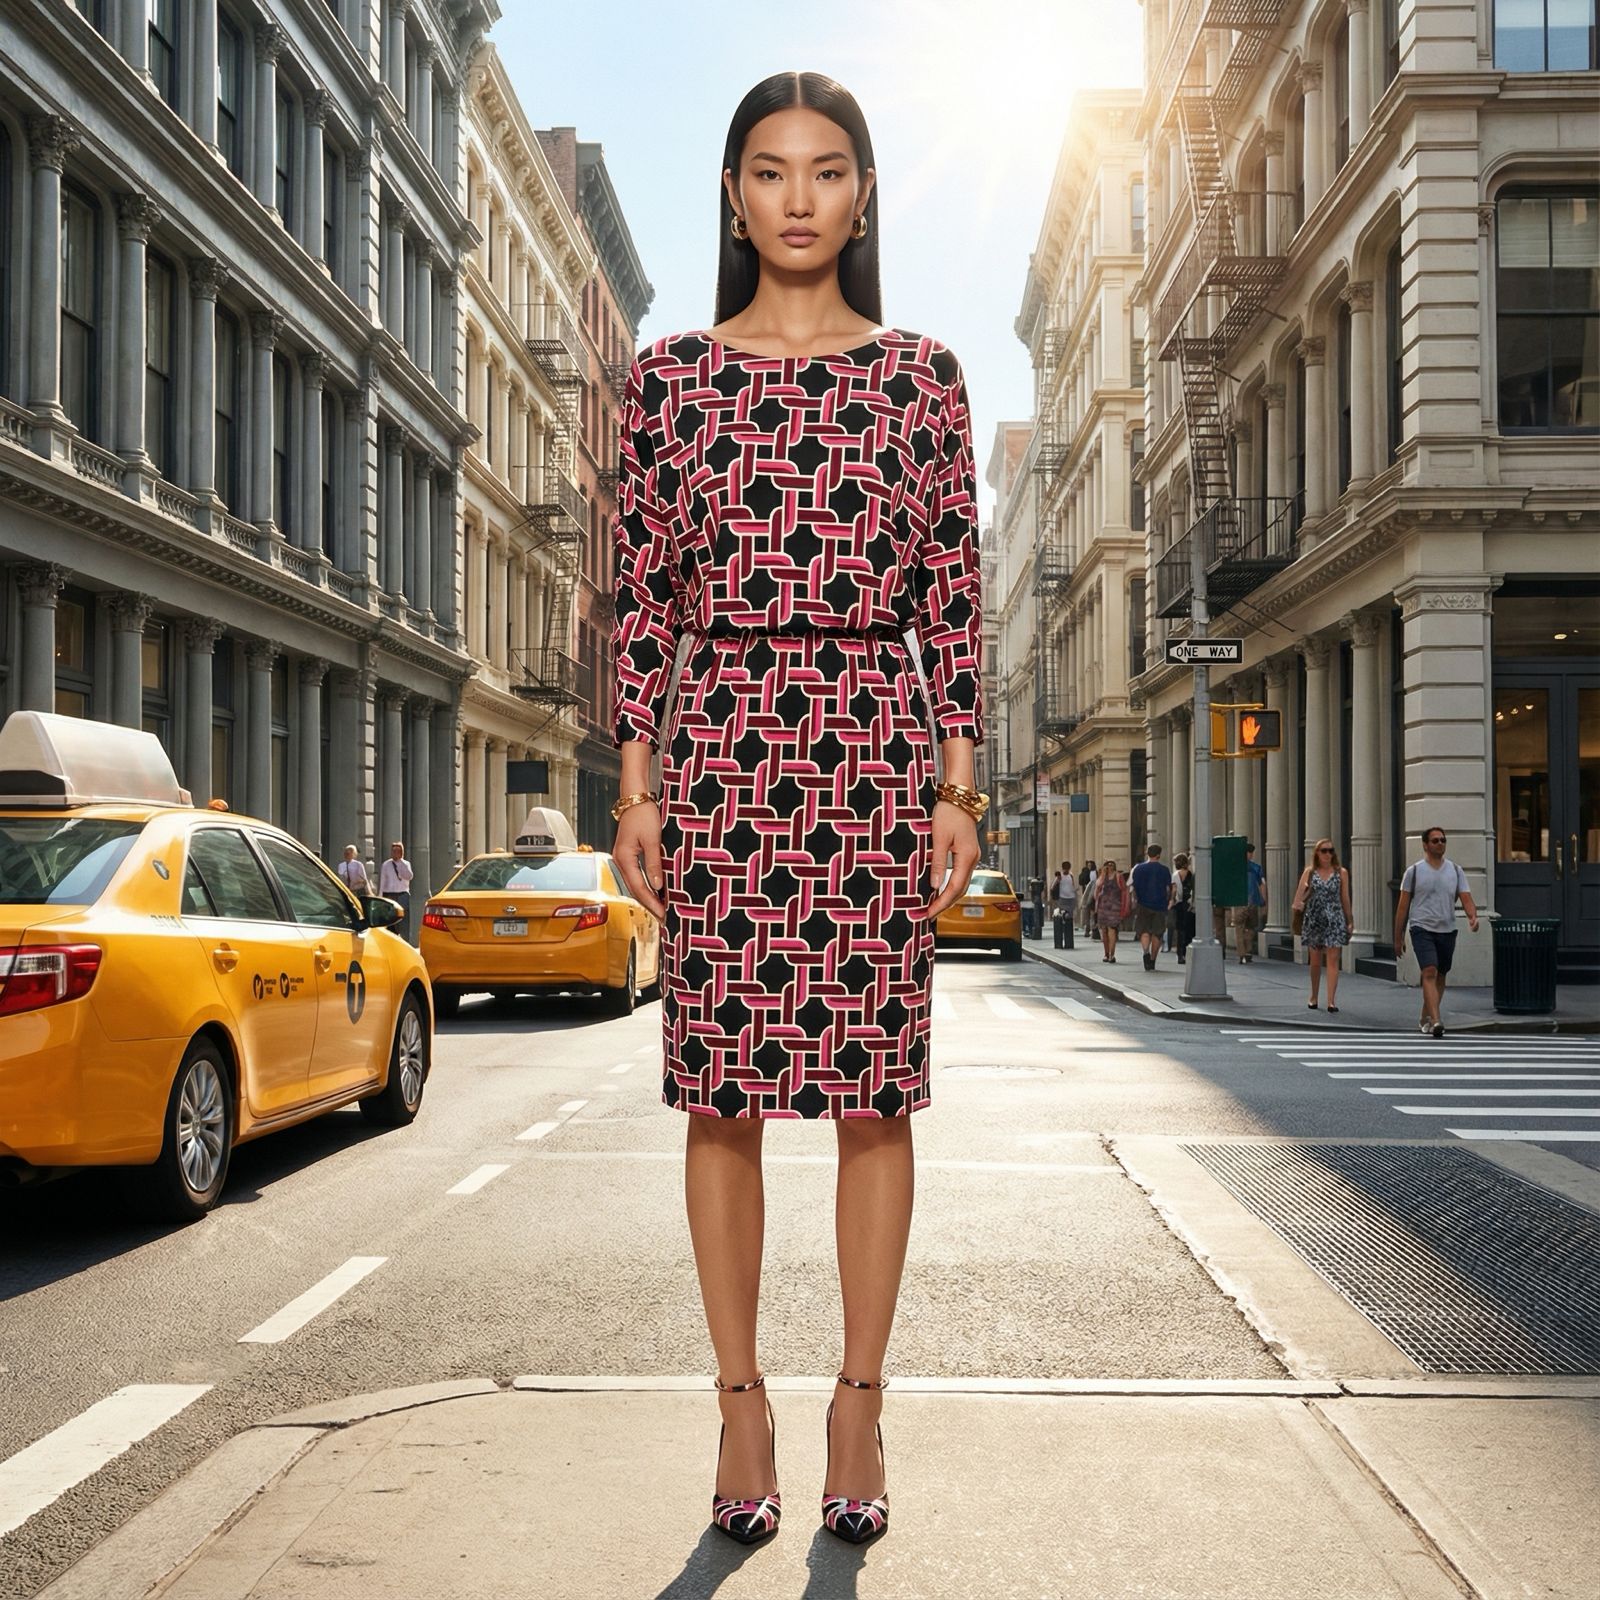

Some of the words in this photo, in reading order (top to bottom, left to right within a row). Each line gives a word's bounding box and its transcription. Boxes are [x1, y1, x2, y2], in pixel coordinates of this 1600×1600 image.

[1176, 646, 1198, 657] ONE
[1209, 646, 1233, 657] WAY
[350, 972, 363, 1013] T
